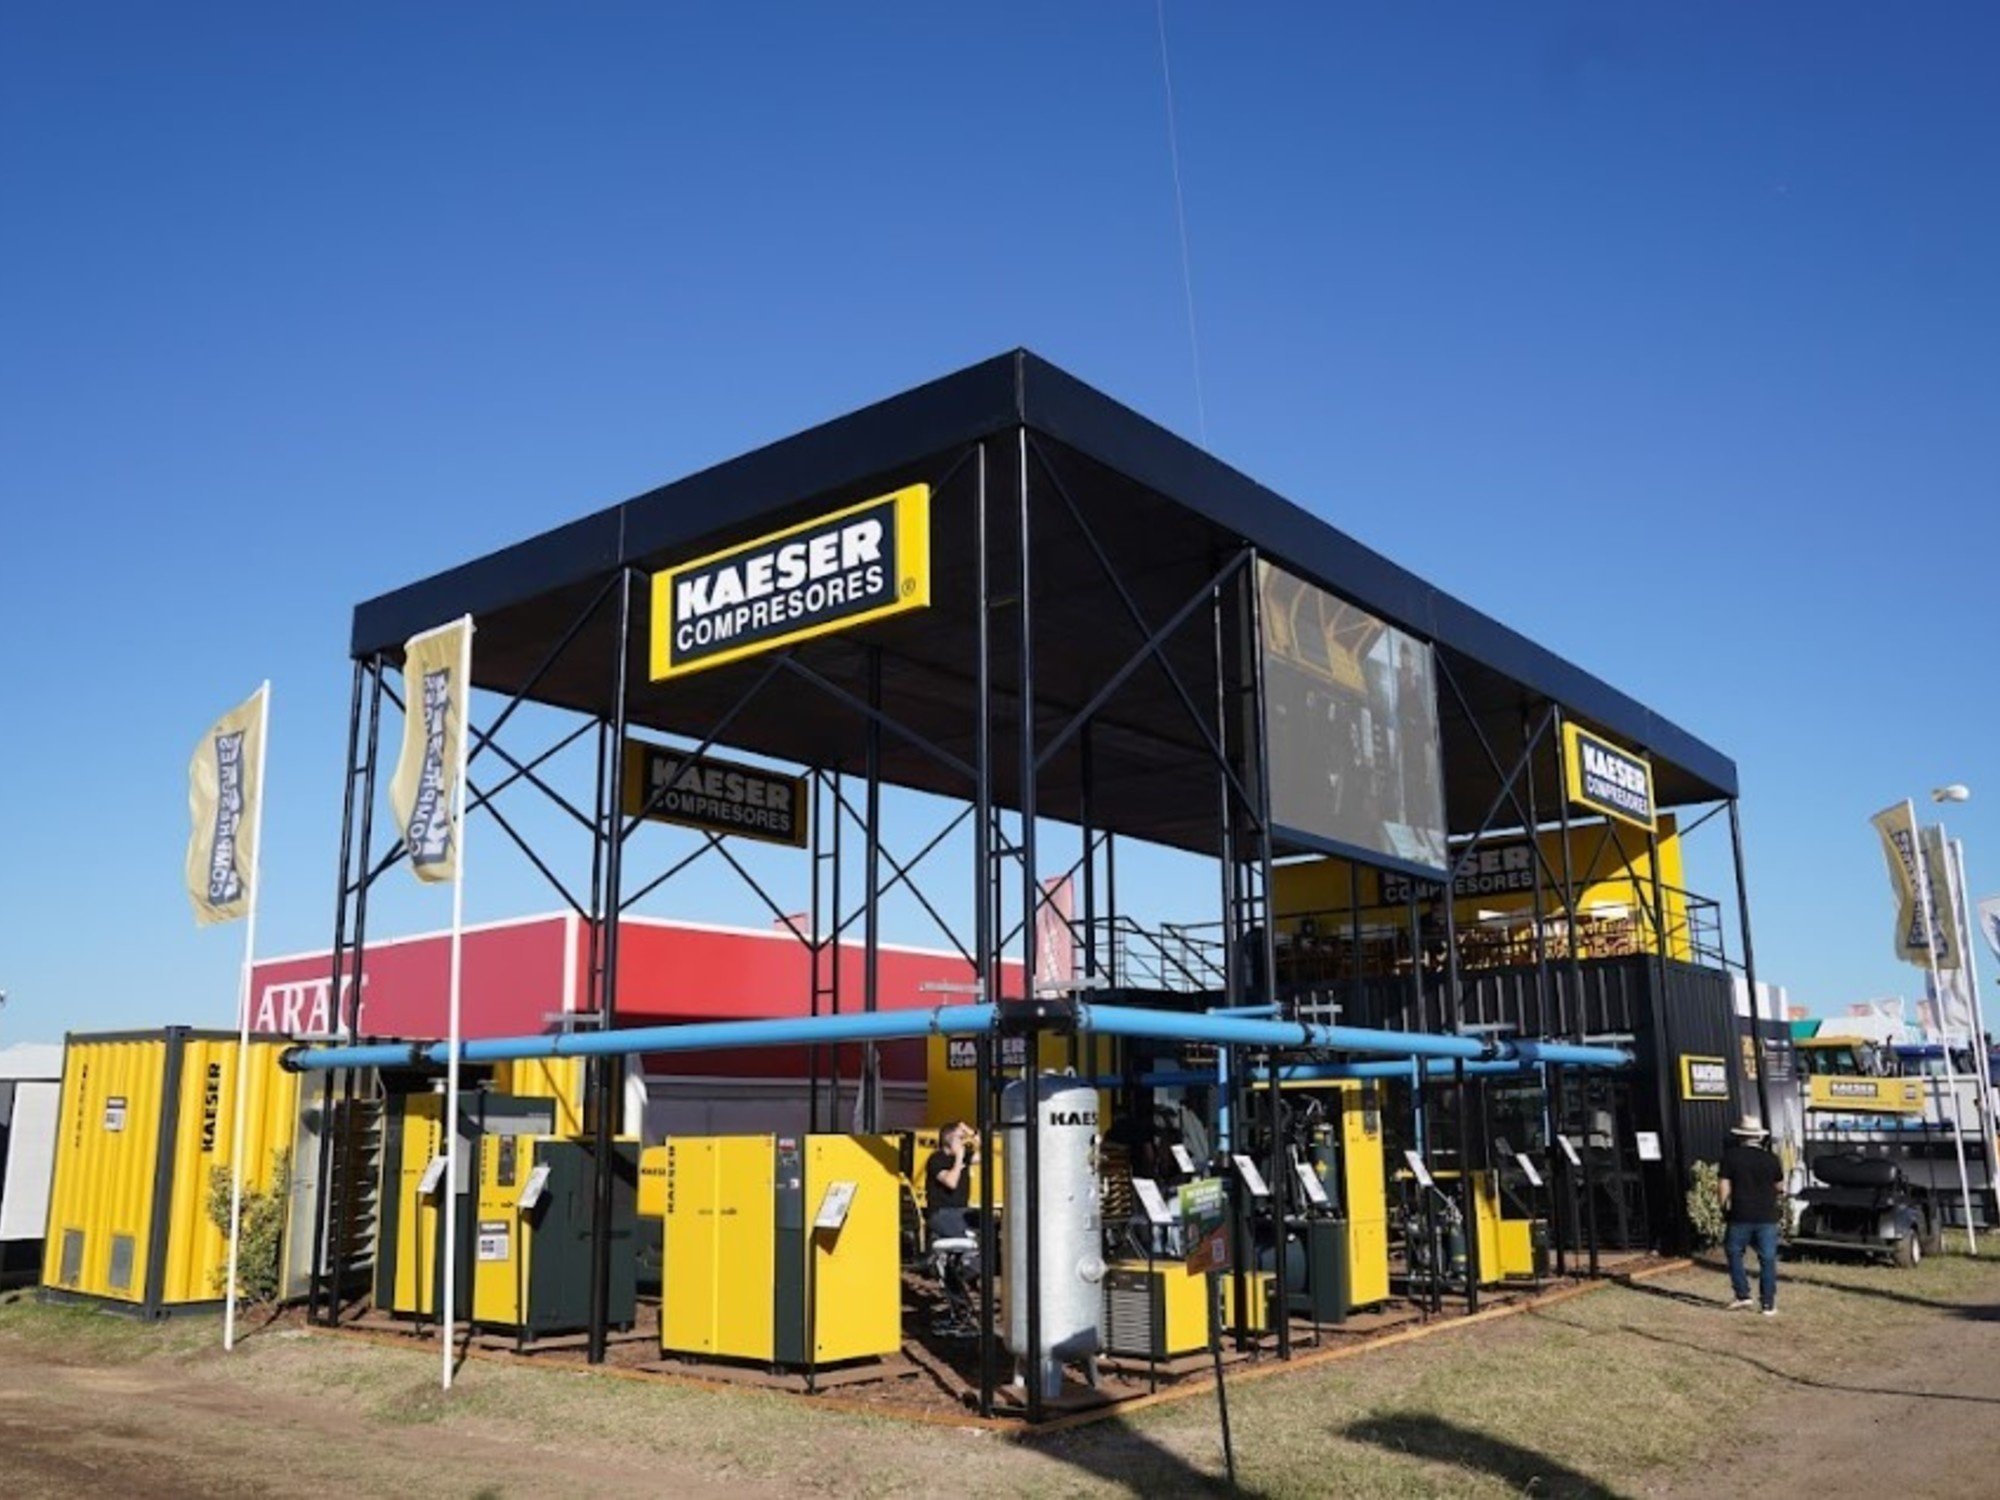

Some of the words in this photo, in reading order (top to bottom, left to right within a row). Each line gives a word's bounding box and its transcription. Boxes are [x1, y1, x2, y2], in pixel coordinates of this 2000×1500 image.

[677, 519, 883, 621] KAESER
[677, 566, 884, 651] COMPRESORES
[652, 758, 790, 811] KAESER
[1582, 743, 1646, 797] KAESER
[651, 790, 790, 831] COMPRESORES
[1386, 872, 1533, 901] COMPESORES
[255, 974, 369, 1034] ARAG
[950, 1038, 1025, 1055] KAER
[202, 1063, 220, 1152] KAESER
